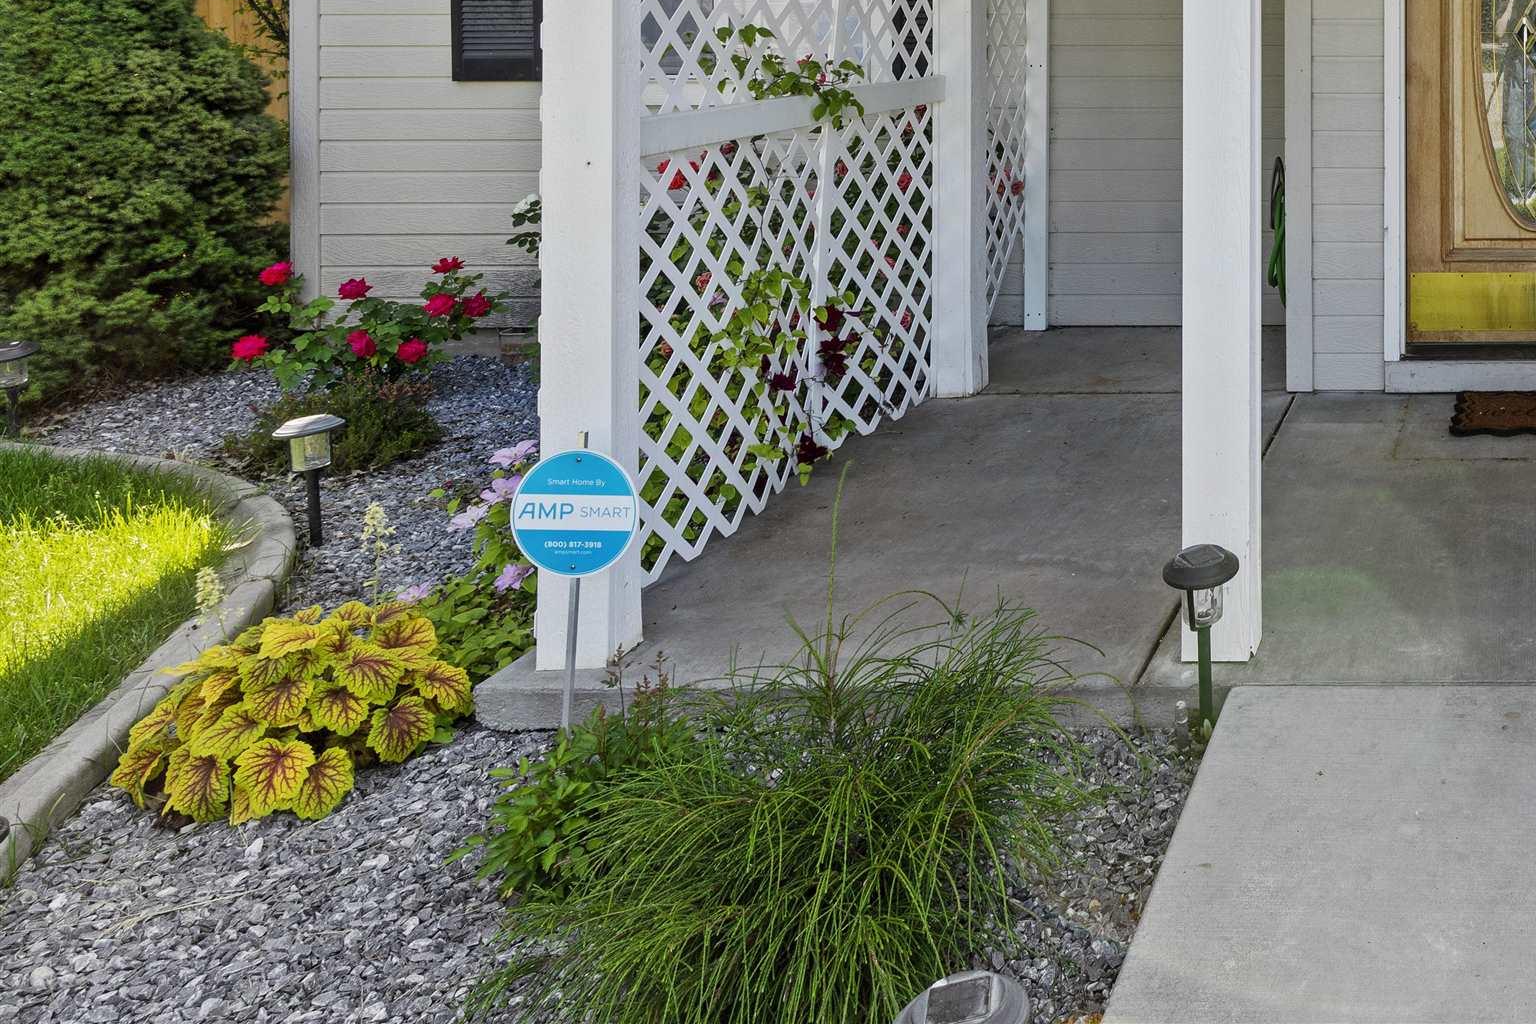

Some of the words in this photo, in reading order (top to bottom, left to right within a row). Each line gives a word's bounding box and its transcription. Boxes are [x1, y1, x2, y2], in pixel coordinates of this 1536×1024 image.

[547, 478, 569, 486] Smart
[595, 479, 606, 487] By
[518, 502, 574, 519] AMP
[580, 506, 631, 519] SMART
[544, 540, 567, 549] (800)
